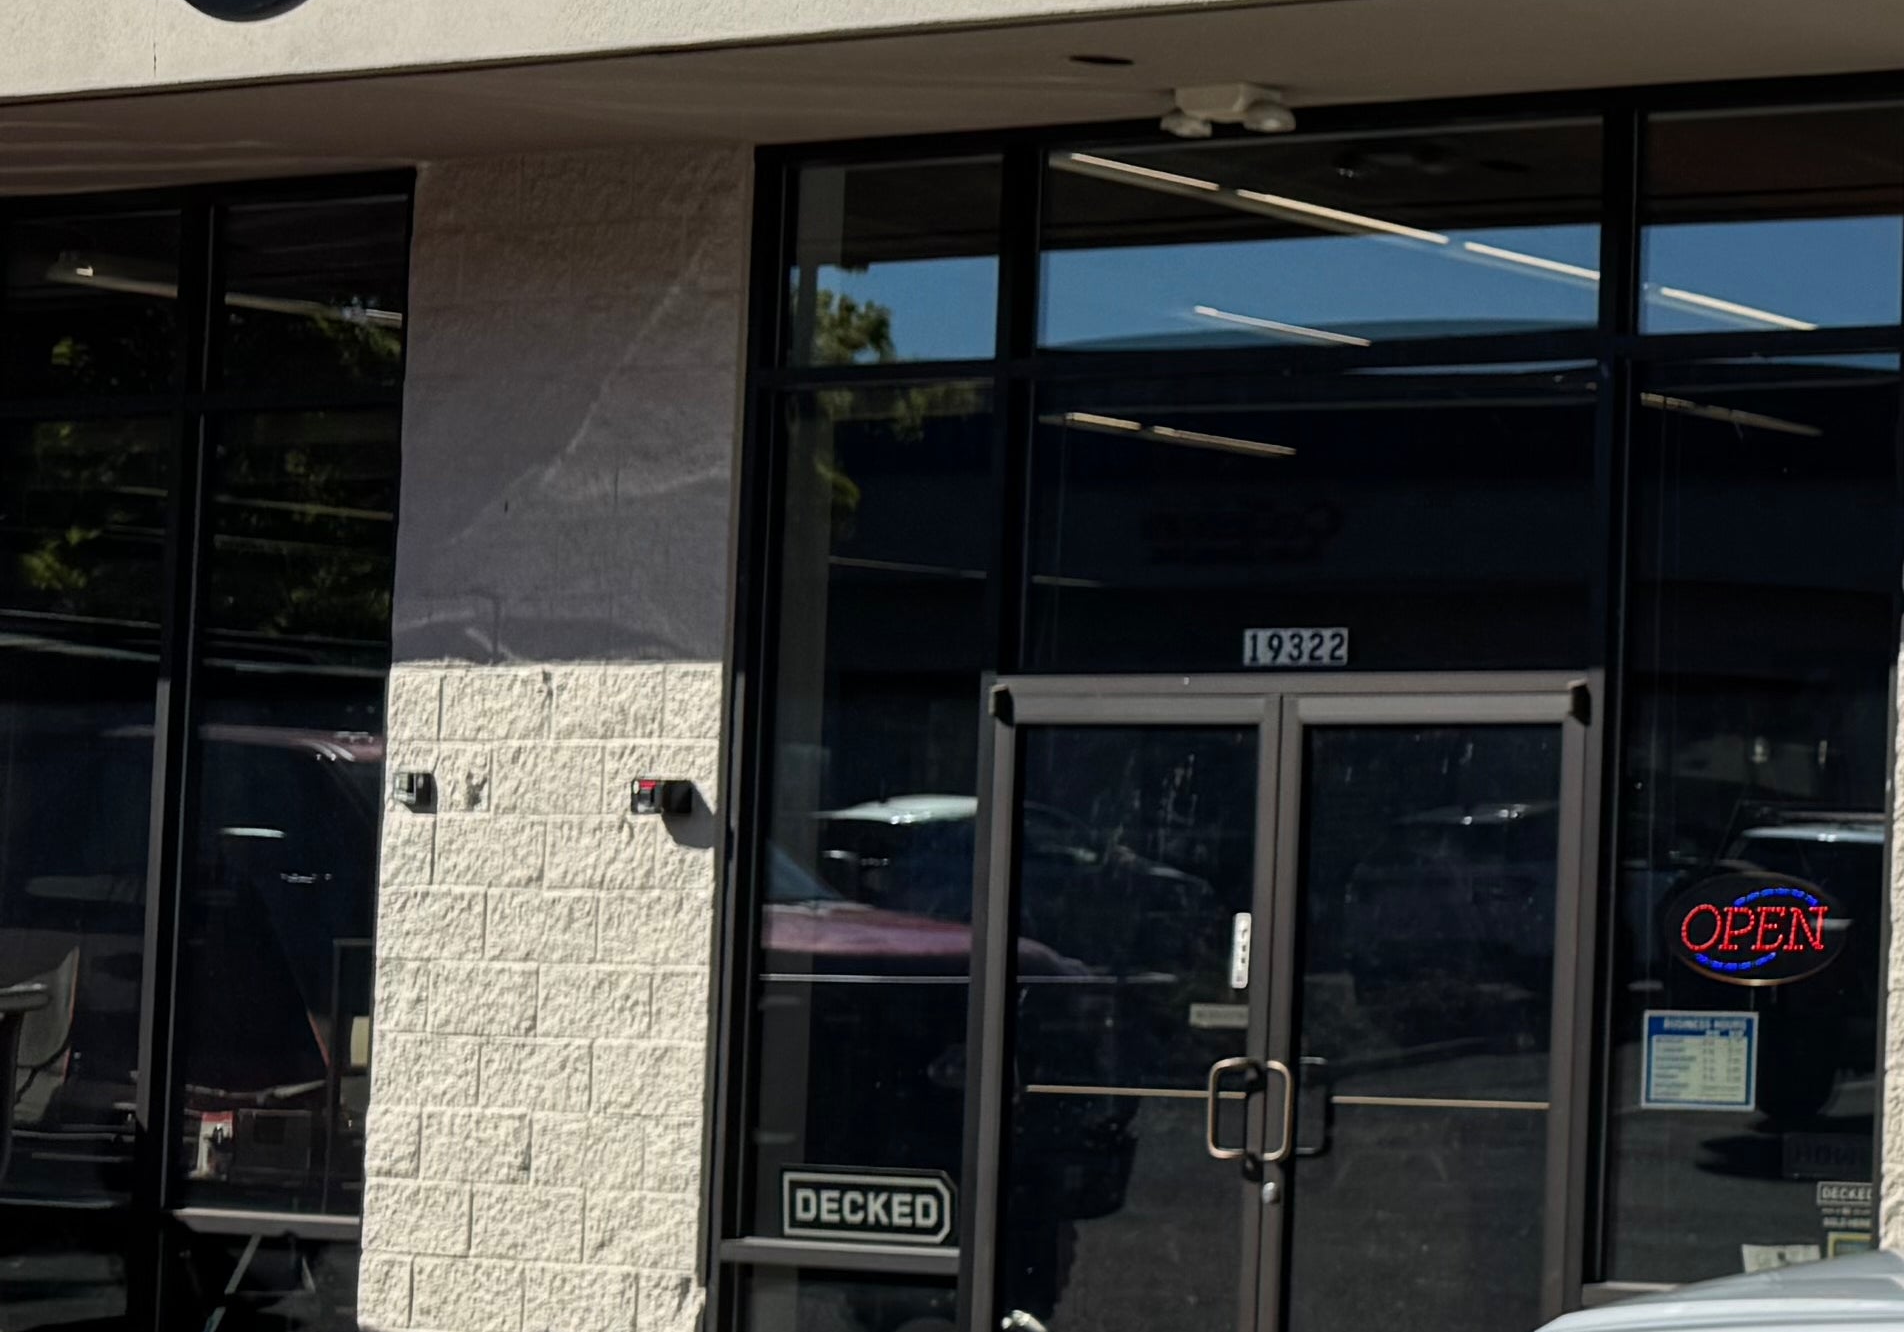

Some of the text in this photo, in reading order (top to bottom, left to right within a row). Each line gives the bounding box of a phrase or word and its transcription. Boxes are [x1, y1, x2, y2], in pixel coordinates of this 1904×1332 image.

[1249, 632, 1345, 662] 19322
[1680, 903, 1828, 952] OPEN
[794, 1187, 939, 1229] DECKED
